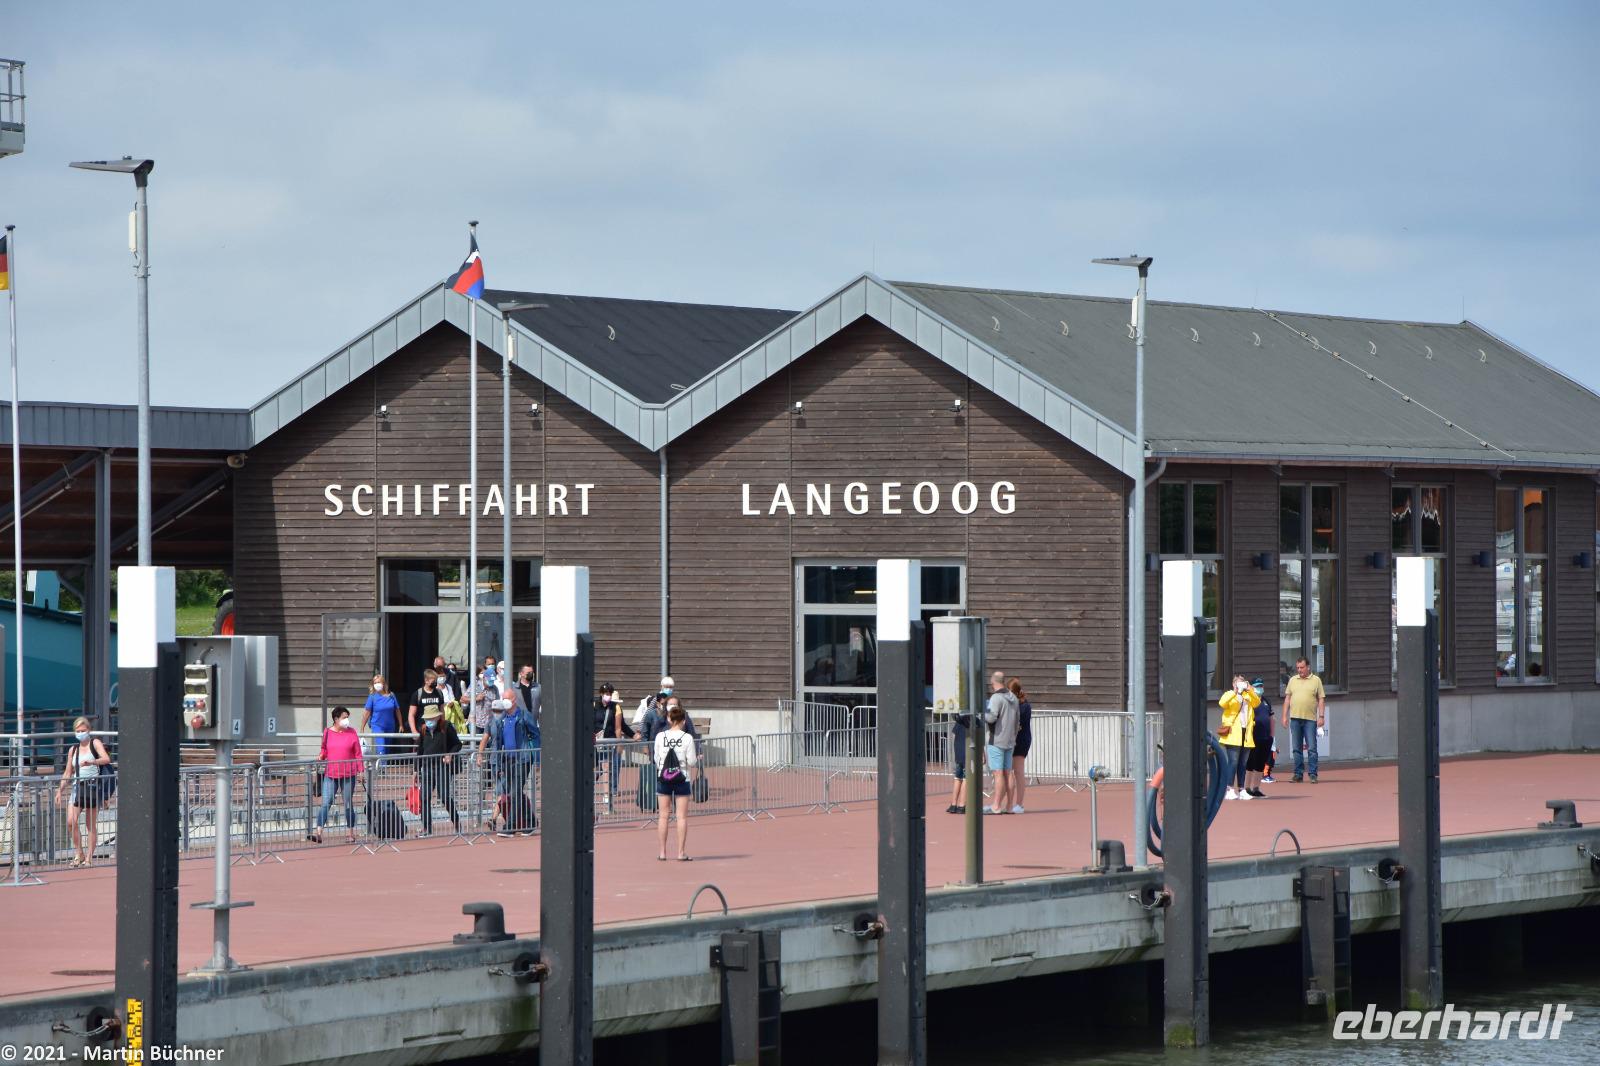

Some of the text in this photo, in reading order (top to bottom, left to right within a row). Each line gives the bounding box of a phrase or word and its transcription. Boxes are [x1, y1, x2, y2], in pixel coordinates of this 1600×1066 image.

[324, 480, 1016, 516] SCHIFFAHRT LANGEOOG
[234, 720, 239, 732] 4
[269, 718, 274, 731] 5
